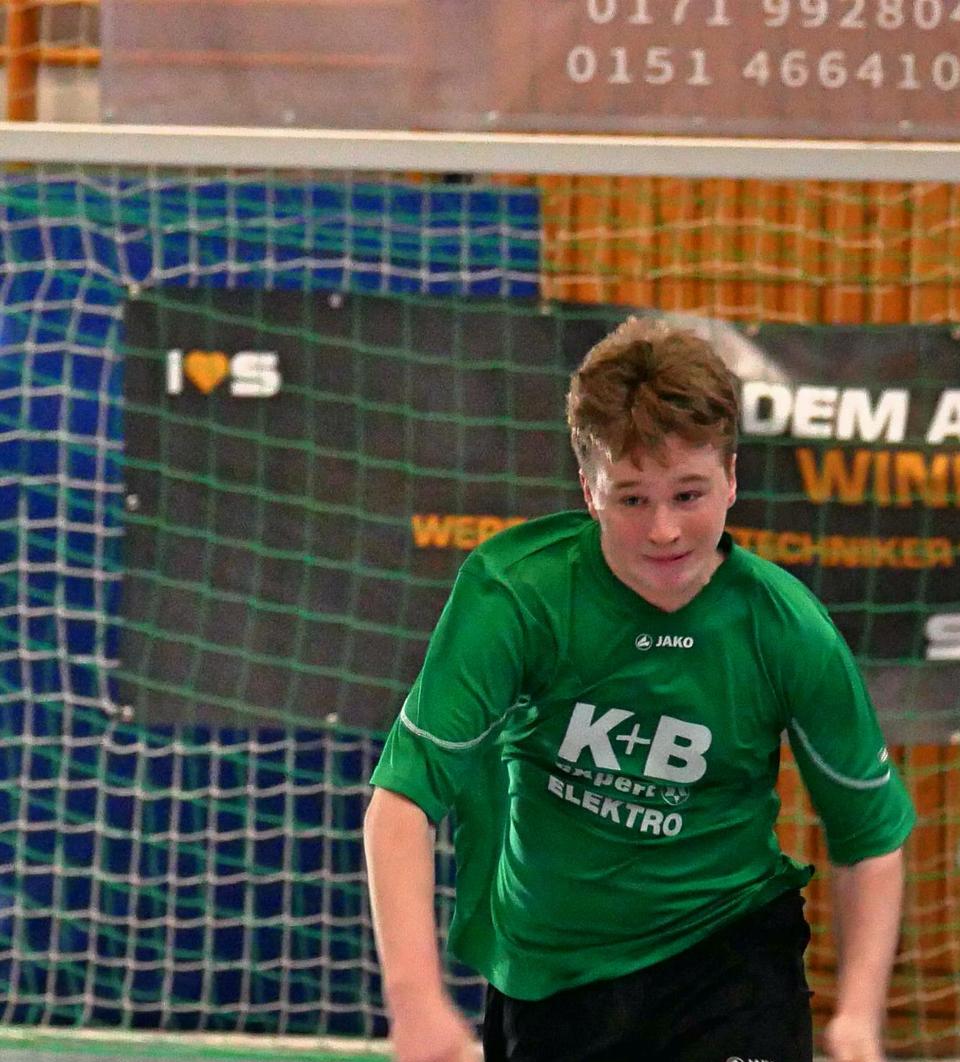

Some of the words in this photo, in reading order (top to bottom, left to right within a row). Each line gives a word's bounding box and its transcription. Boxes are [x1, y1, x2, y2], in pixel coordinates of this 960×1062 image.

[587, 0, 731, 26] 0171
[566, 46, 713, 86] 0151
[230, 351, 281, 397] S
[740, 378, 911, 442] DEM
[411, 513, 528, 551] WER
[656, 635, 694, 648] JAKO
[557, 702, 713, 783] K+B
[547, 774, 683, 836] ELEKTRO
